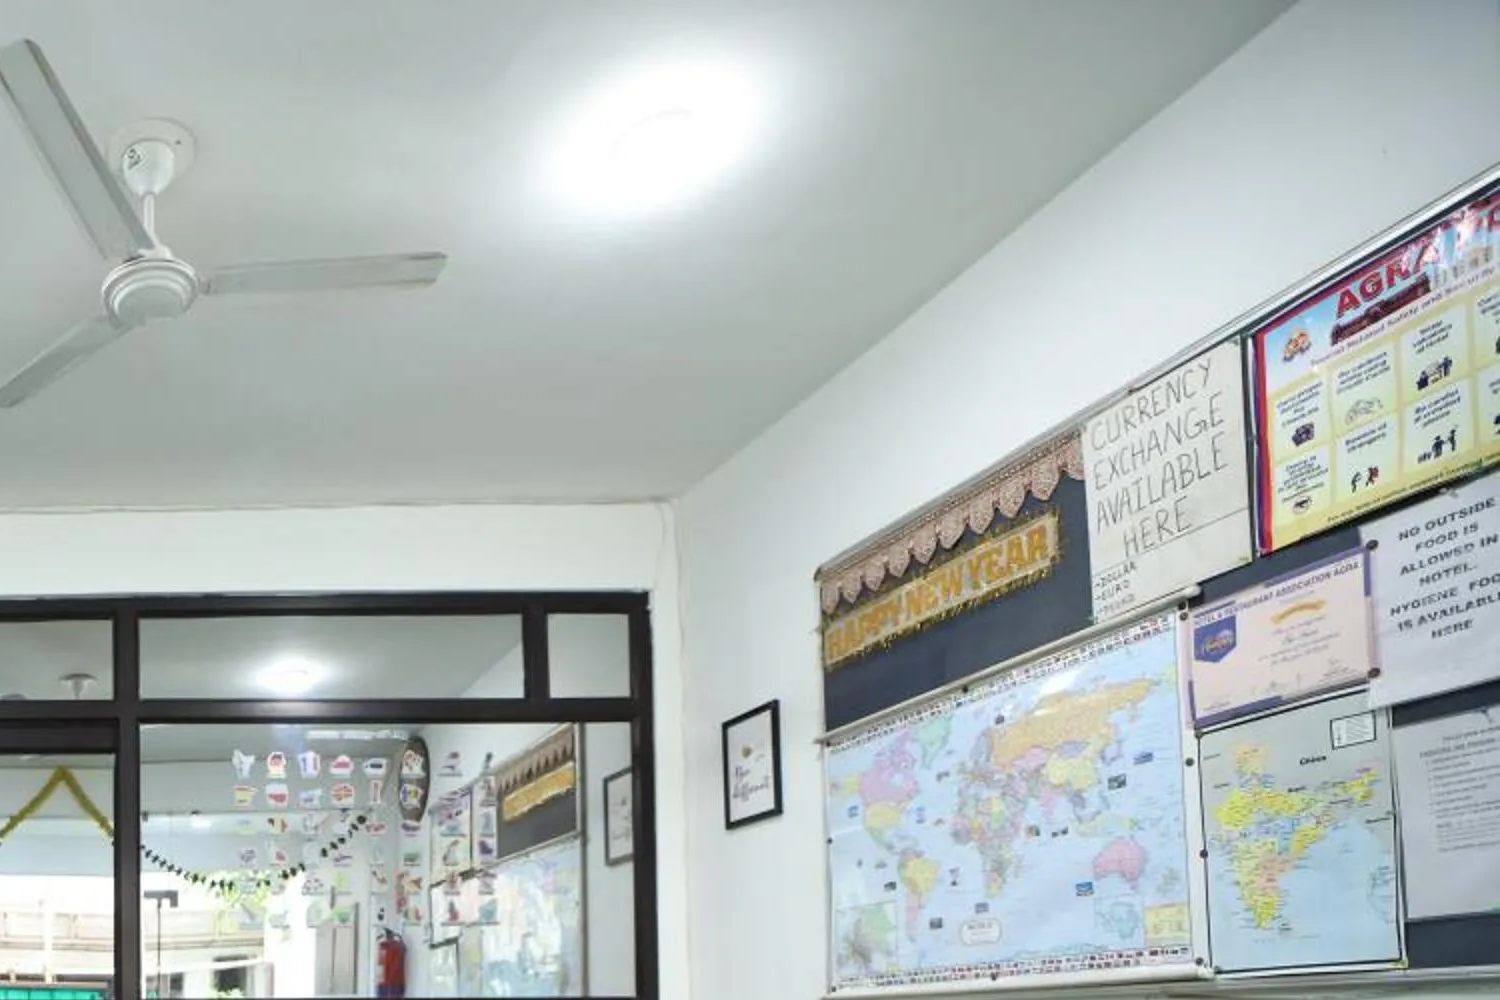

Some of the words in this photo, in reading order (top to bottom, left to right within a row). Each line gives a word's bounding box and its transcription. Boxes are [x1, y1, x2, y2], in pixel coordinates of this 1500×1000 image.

[1091, 357, 1212, 451] CURRENCY
[1094, 392, 1224, 491] EXCHANGE
[1097, 432, 1228, 532] AVAILABLE
[1124, 496, 1192, 558] HERE
[1398, 525, 1421, 541] NO
[1425, 497, 1496, 531] OUTSIDE
[1415, 527, 1459, 551] FOOD
[1463, 521, 1479, 536] IS
[967, 525, 1047, 586] YEAR
[1400, 542, 1476, 576] ALLOWED
[1480, 533, 1498, 548] IN
[1390, 586, 1459, 617] HYGIENE
[1468, 573, 1500, 592] FOO
[1398, 619, 1413, 632] IS
[1431, 619, 1474, 639] HERE
